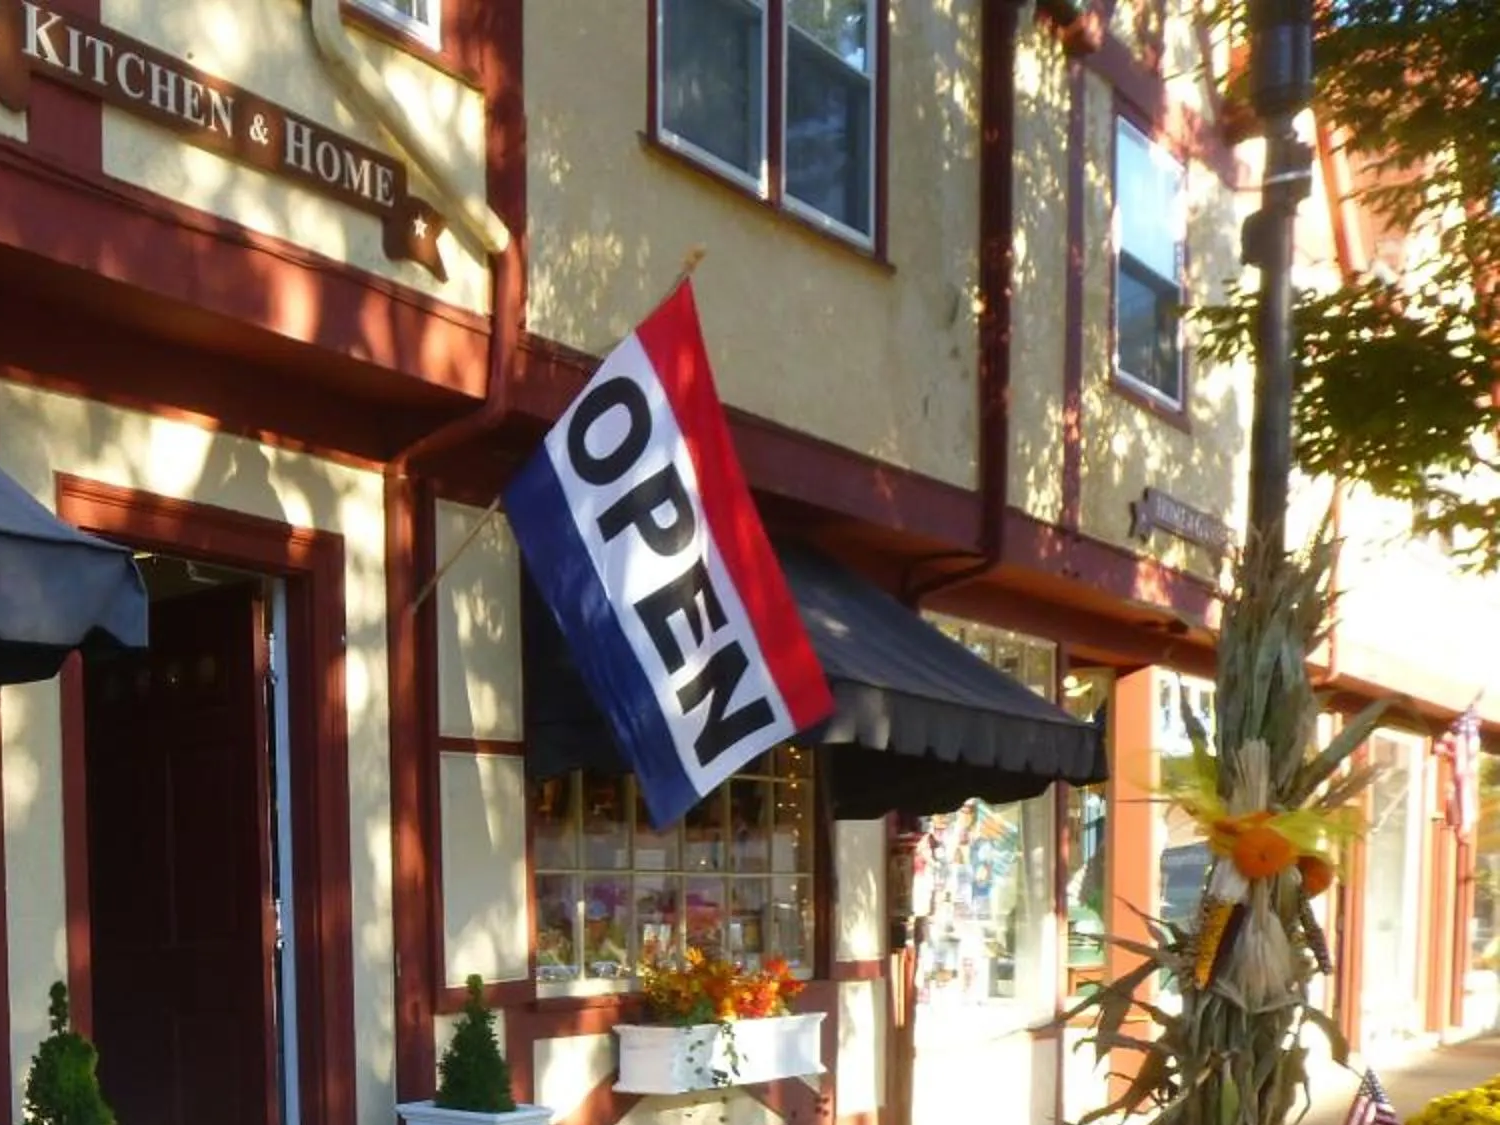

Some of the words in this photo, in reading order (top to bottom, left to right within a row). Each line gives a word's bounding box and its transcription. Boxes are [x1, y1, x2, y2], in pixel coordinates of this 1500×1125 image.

[21, 1, 235, 138] KITCHEN
[248, 113, 270, 145] &
[283, 117, 395, 208] HOME
[567, 375, 776, 768] OPEN
